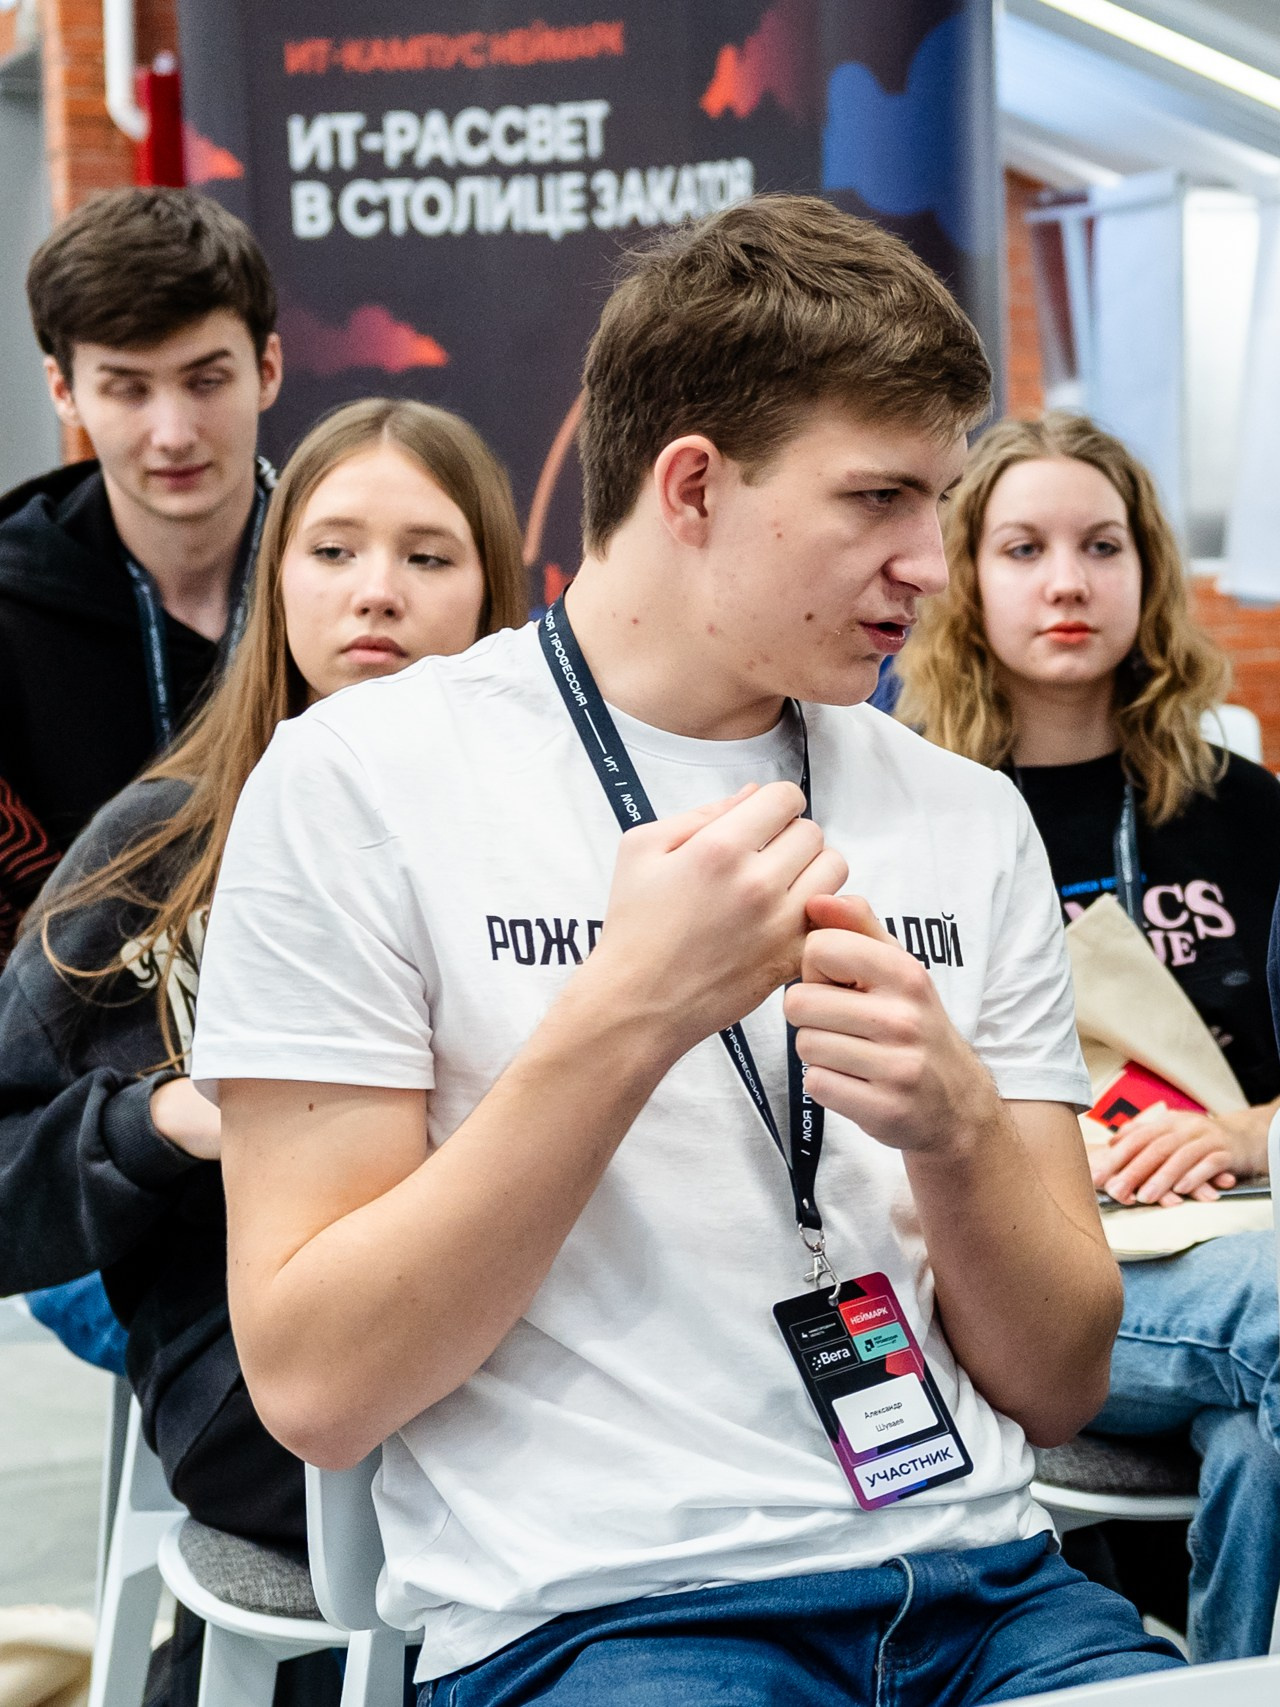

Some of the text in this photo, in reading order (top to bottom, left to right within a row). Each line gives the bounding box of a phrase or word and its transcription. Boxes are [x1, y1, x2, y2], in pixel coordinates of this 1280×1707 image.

[287, 100, 610, 171] ИТ-РАССВЕТ
[291, 181, 334, 239] В
[338, 171, 587, 240] СТОЛИЦЕ
[549, 632, 588, 707] ПРОФЕССИЯ
[603, 756, 619, 772] ИТ
[621, 793, 642, 823] МОЯ
[1143, 879, 1236, 939] CS
[885, 911, 964, 970] ДОЙ
[725, 1026, 764, 1106] ПРОФЕССИЯ
[802, 1110, 813, 1142] МОЯ
[850, 1306, 888, 1325] НЕЙМАРК
[820, 1347, 851, 1365] Вега
[864, 1401, 903, 1419] Александр
[865, 1447, 953, 1487] УЧАСТНИК
